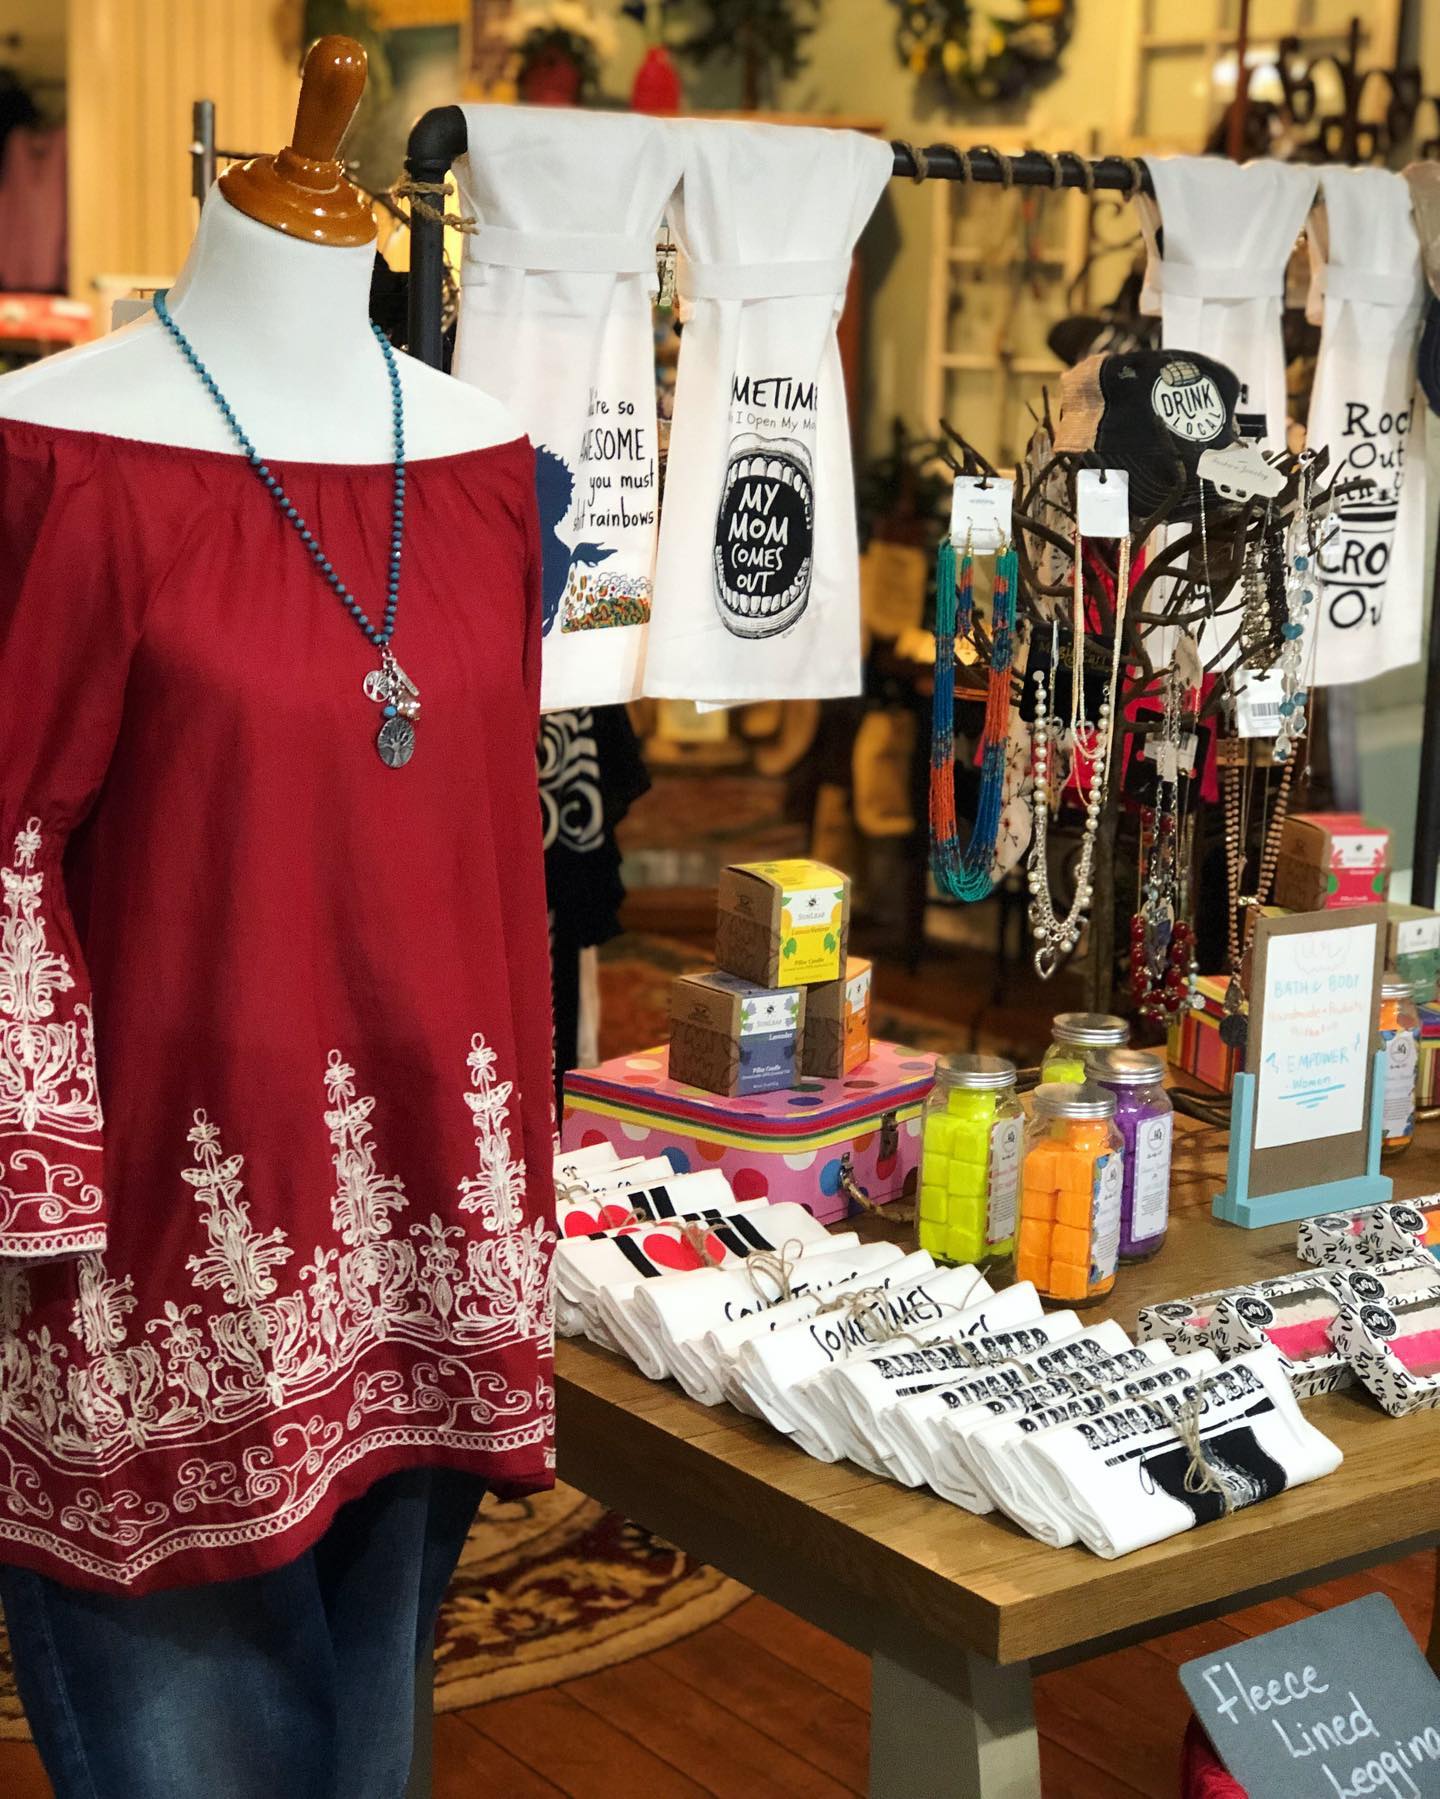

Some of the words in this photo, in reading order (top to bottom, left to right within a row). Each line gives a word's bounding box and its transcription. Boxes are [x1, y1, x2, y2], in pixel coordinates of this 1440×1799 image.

[731, 371, 818, 411] METIM
[1161, 383, 1215, 419] DRINK
[618, 400, 635, 415] so
[747, 412, 776, 430] Open
[782, 416, 798, 433] My
[1172, 411, 1222, 436] LOCAL
[1349, 441, 1403, 469] Out
[587, 474, 612, 507] you
[620, 457, 655, 489] must
[589, 496, 655, 529] rainbows
[738, 482, 780, 517] MY
[728, 512, 789, 546] MOM
[731, 543, 784, 572] COMES
[736, 571, 776, 593] OUT
[1273, 980, 1308, 998] BATH
[1328, 974, 1360, 992] BODY
[1287, 1047, 1349, 1073] EMPOWER
[1202, 1661, 1330, 1724] Fleece
[1271, 1691, 1381, 1759] Lined
